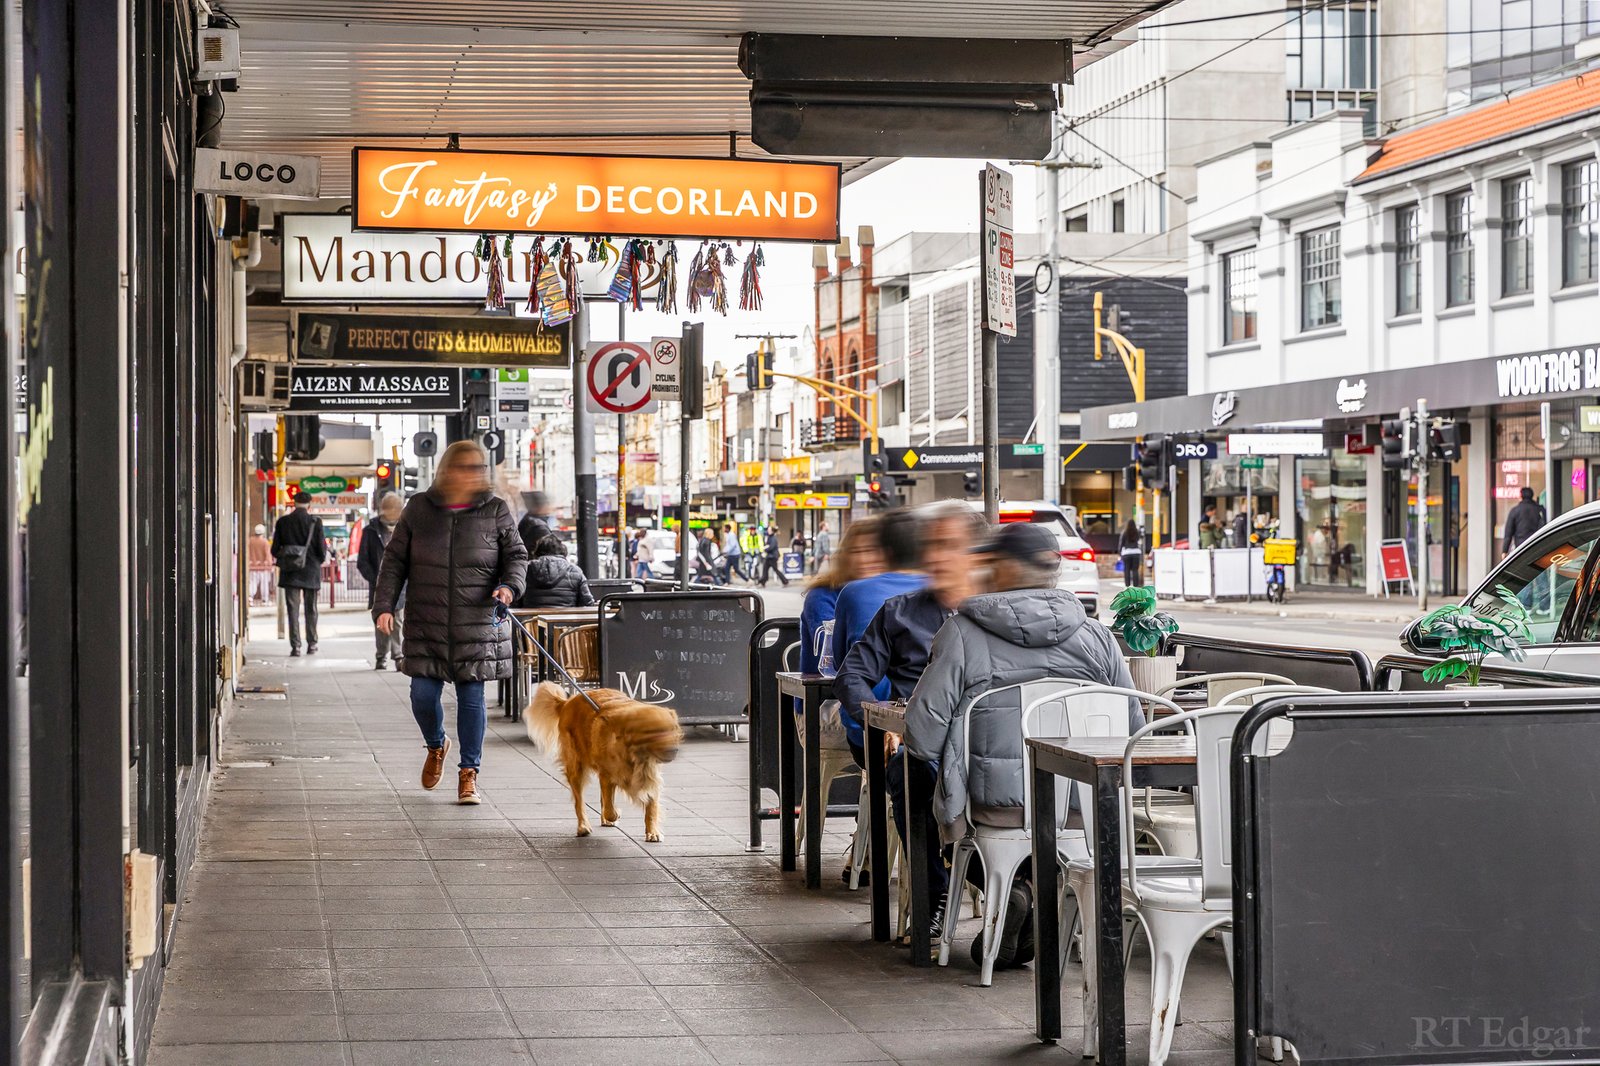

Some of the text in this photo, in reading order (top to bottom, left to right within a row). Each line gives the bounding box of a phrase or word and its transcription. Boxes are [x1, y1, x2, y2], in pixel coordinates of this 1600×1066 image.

[220, 160, 296, 185] LOCO
[378, 159, 818, 228] Fantasy DECORLAND
[988, 228, 998, 255] 1P
[348, 328, 410, 350] PERFECT
[413, 330, 454, 351] GIFTS
[469, 333, 562, 355] HOMEWARES
[655, 374, 676, 382] CYCLING
[1496, 350, 1581, 397] WOODFROG
[291, 376, 450, 392] AIZEN MASSAGE
[651, 384, 680, 393] PROHIBITED
[920, 452, 979, 464] Commonwealth
[302, 479, 345, 490] Specsavers
